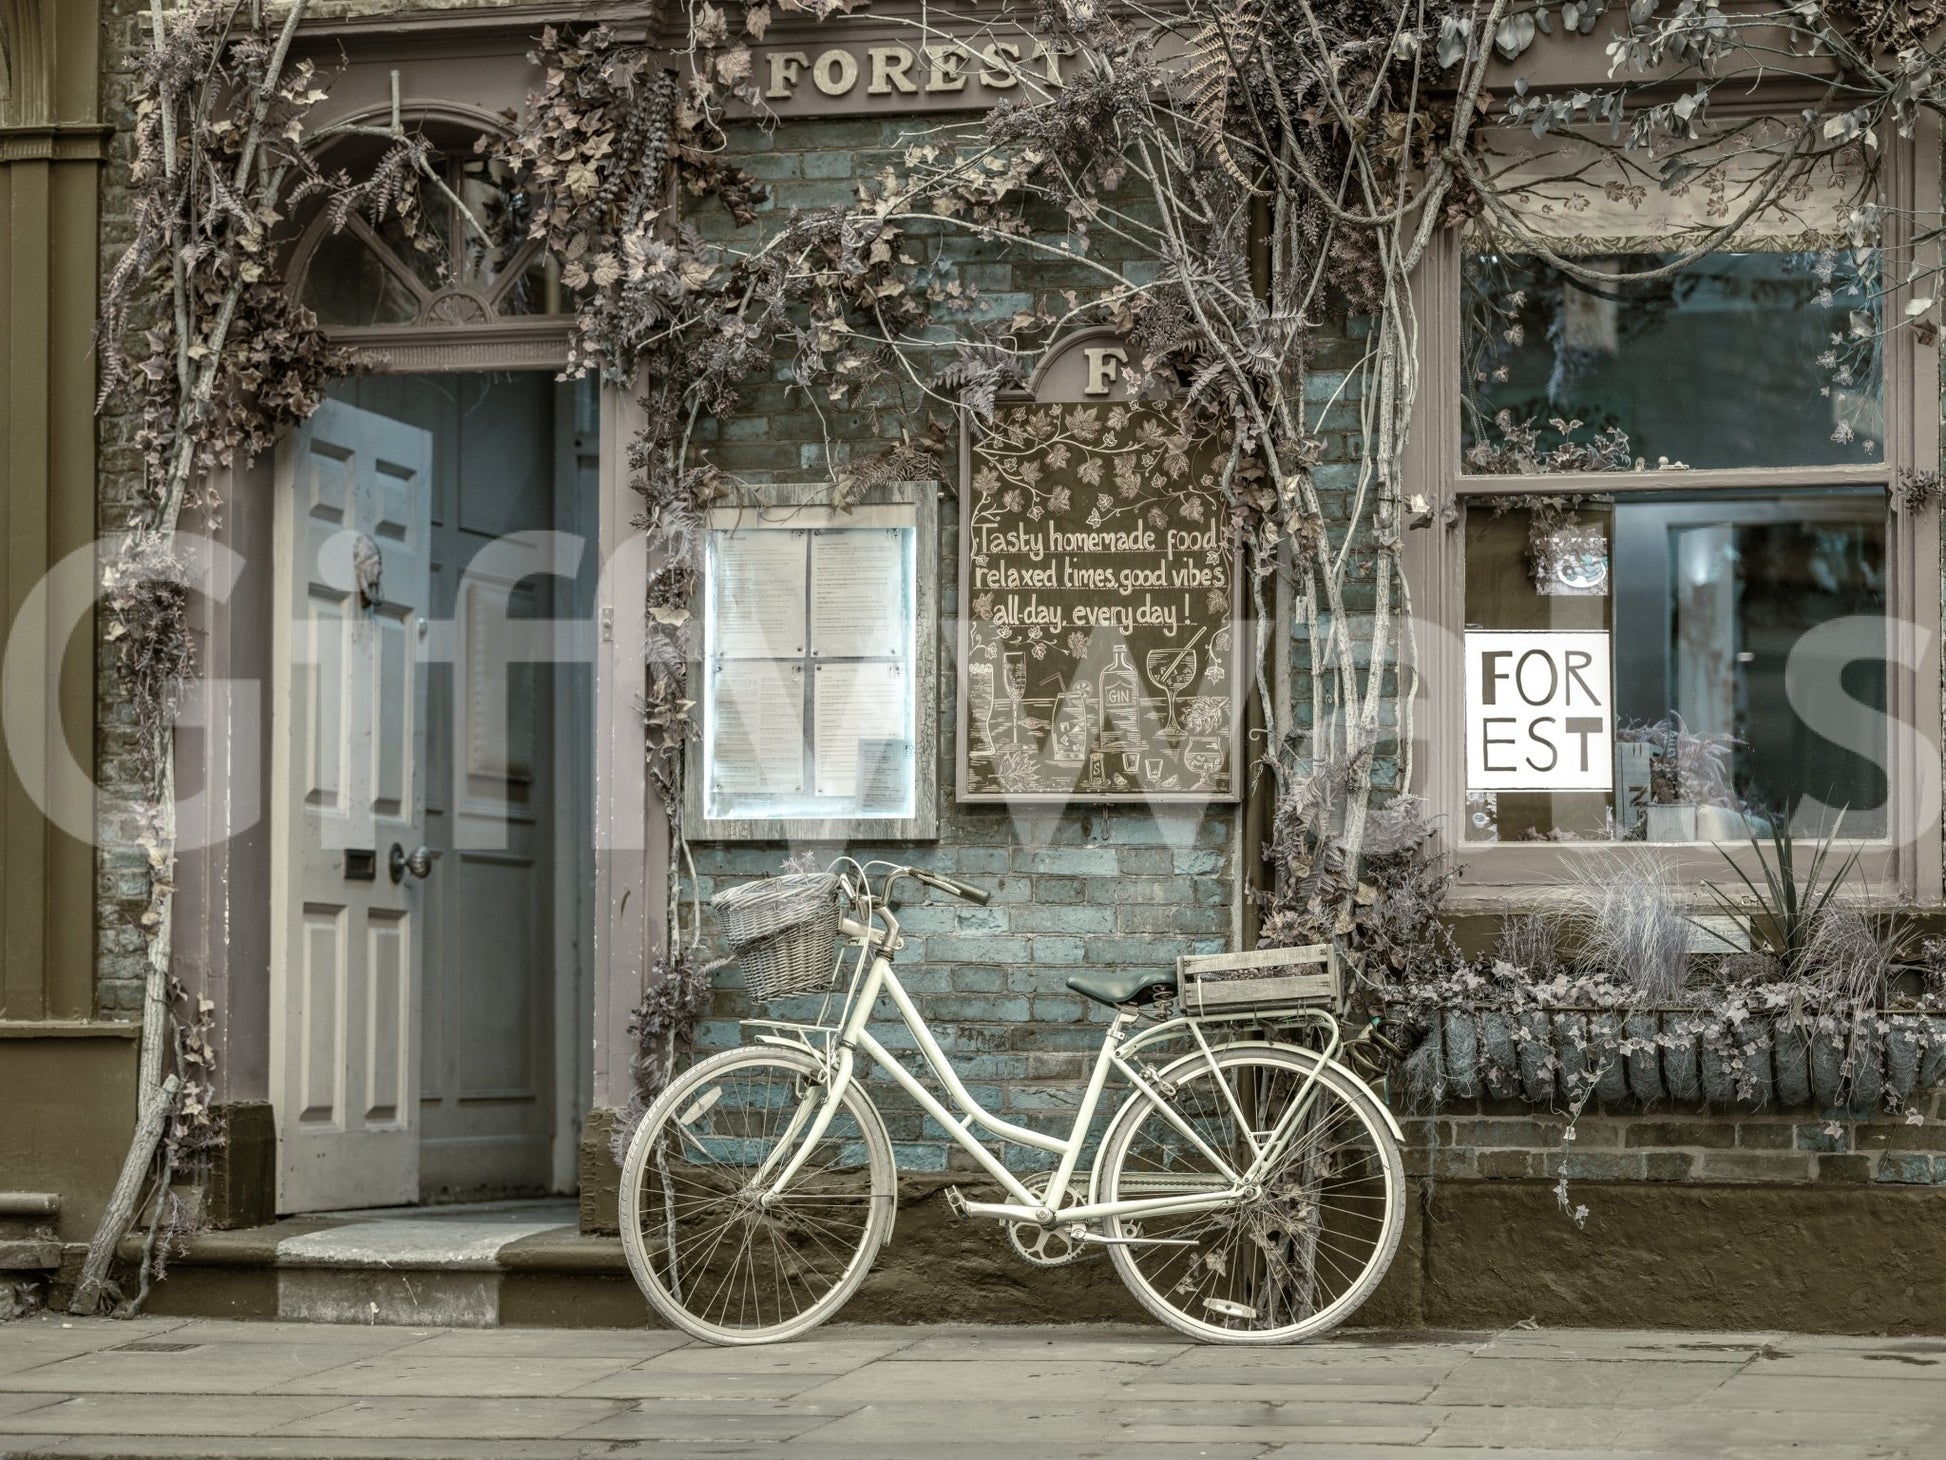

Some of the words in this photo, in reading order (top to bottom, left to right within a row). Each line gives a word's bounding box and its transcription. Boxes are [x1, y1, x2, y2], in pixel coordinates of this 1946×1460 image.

[765, 39, 1076, 98] FOREST
[1084, 347, 1129, 394] F
[973, 522, 1044, 560] Tasty
[1049, 519, 1156, 551] homemade
[975, 558, 1057, 588] relaxed
[1171, 557, 1225, 587] vibes
[1108, 689, 1130, 703] GIN
[1481, 649, 1601, 706] FOR
[1483, 716, 1603, 772] EST
